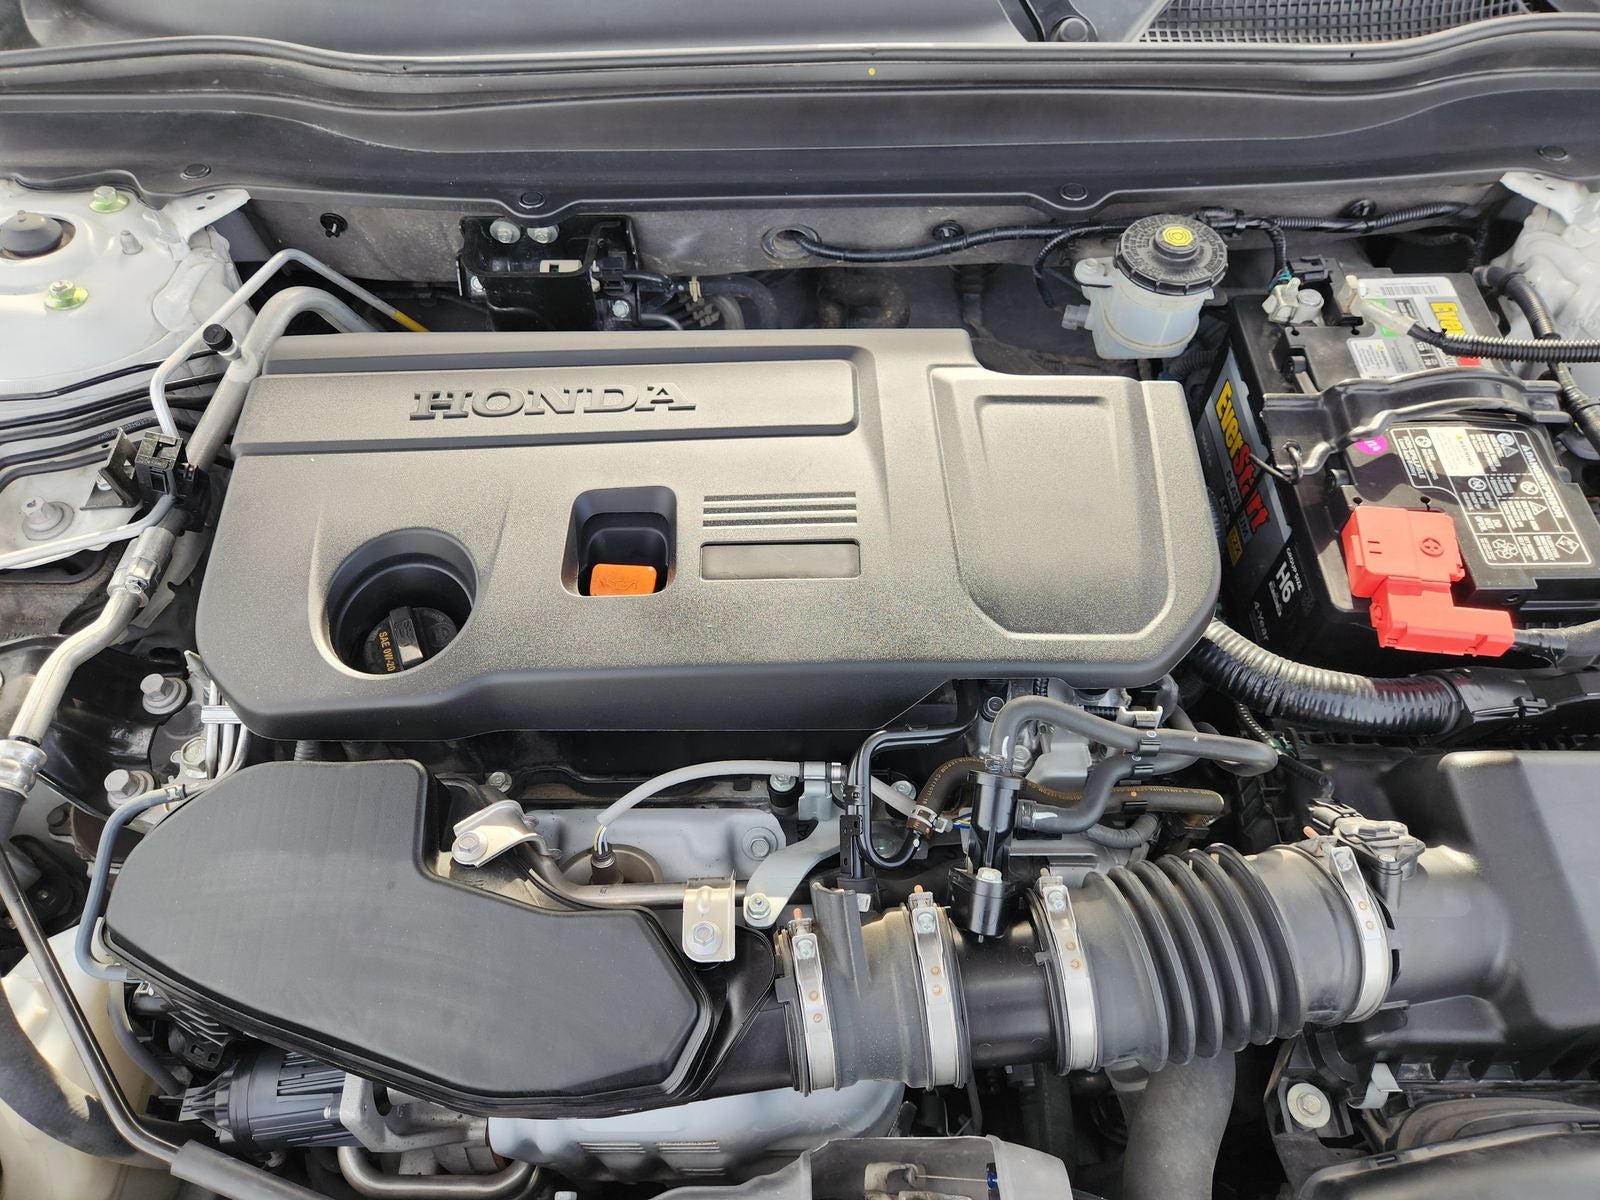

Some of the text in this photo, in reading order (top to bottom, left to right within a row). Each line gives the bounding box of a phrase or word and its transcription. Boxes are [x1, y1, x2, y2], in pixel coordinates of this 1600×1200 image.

[409, 382, 696, 420] HONDA
[1226, 470, 1250, 538] PLATIUM
[1276, 561, 1295, 603] H6
[1254, 601, 1269, 641] 4-Year
[378, 631, 396, 672] SAE 0W-20
